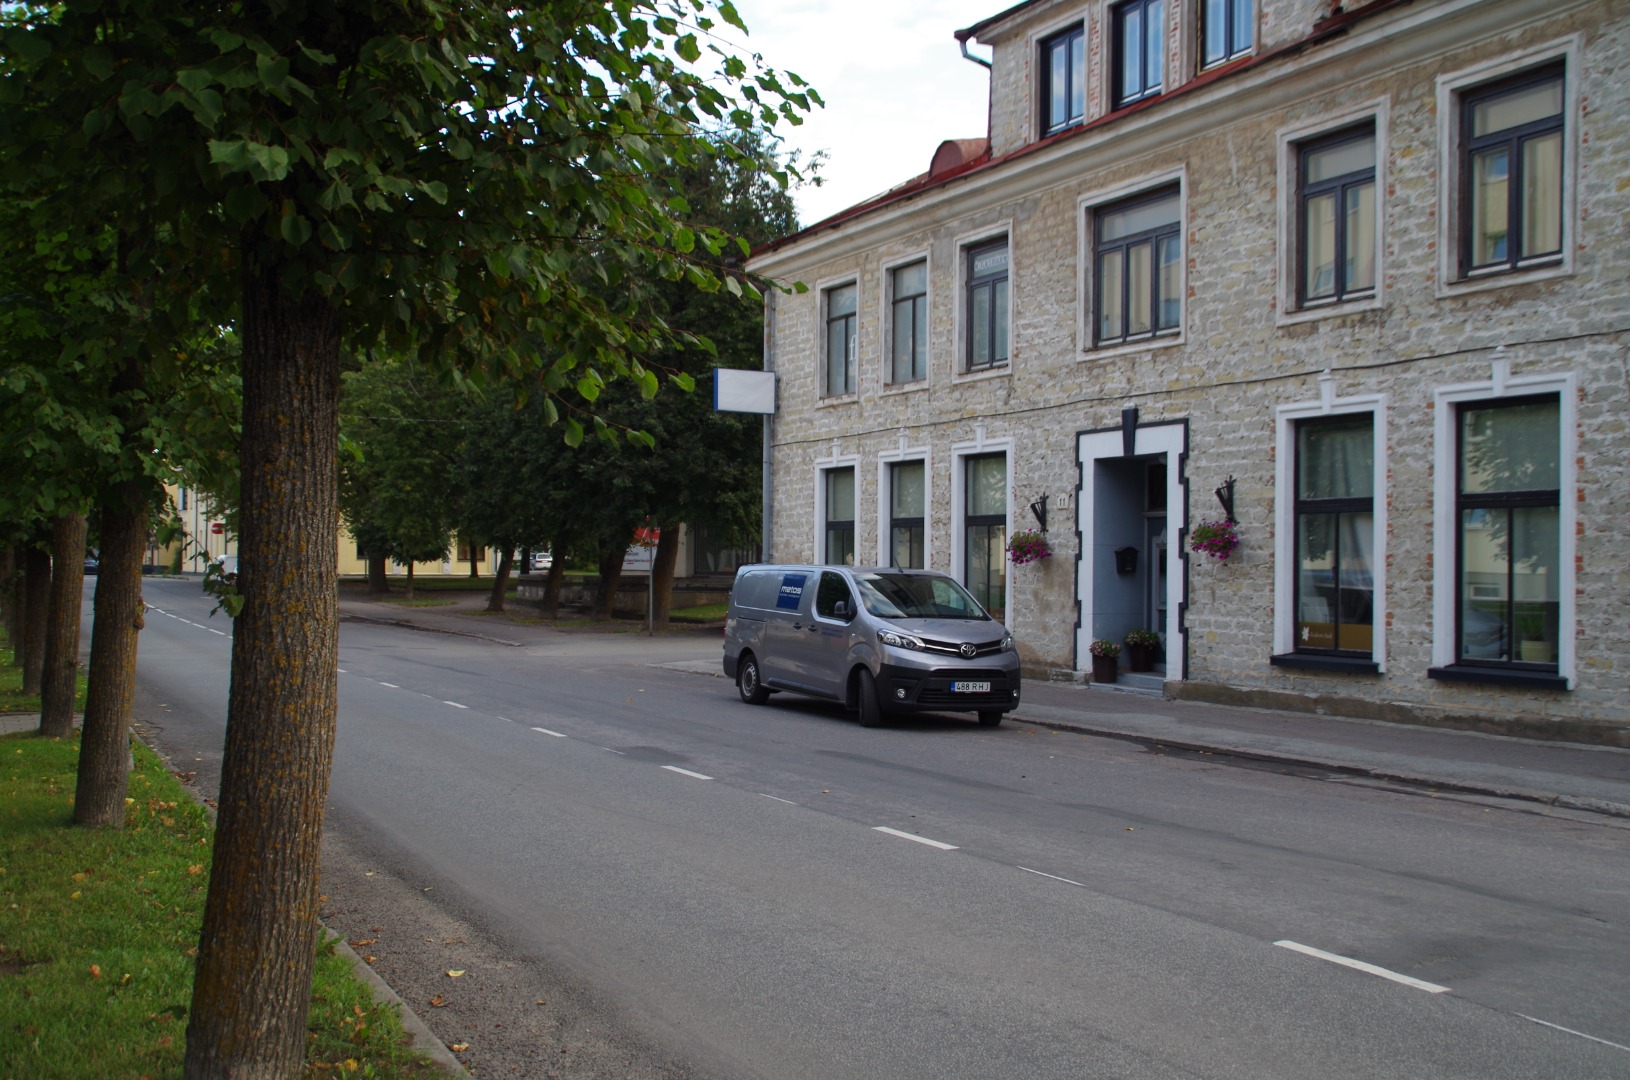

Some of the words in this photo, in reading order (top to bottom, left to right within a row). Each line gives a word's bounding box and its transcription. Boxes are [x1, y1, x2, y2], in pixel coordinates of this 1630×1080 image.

[781, 585, 803, 595] metos
[956, 682, 970, 691] 488
[972, 682, 989, 691] RHJ
